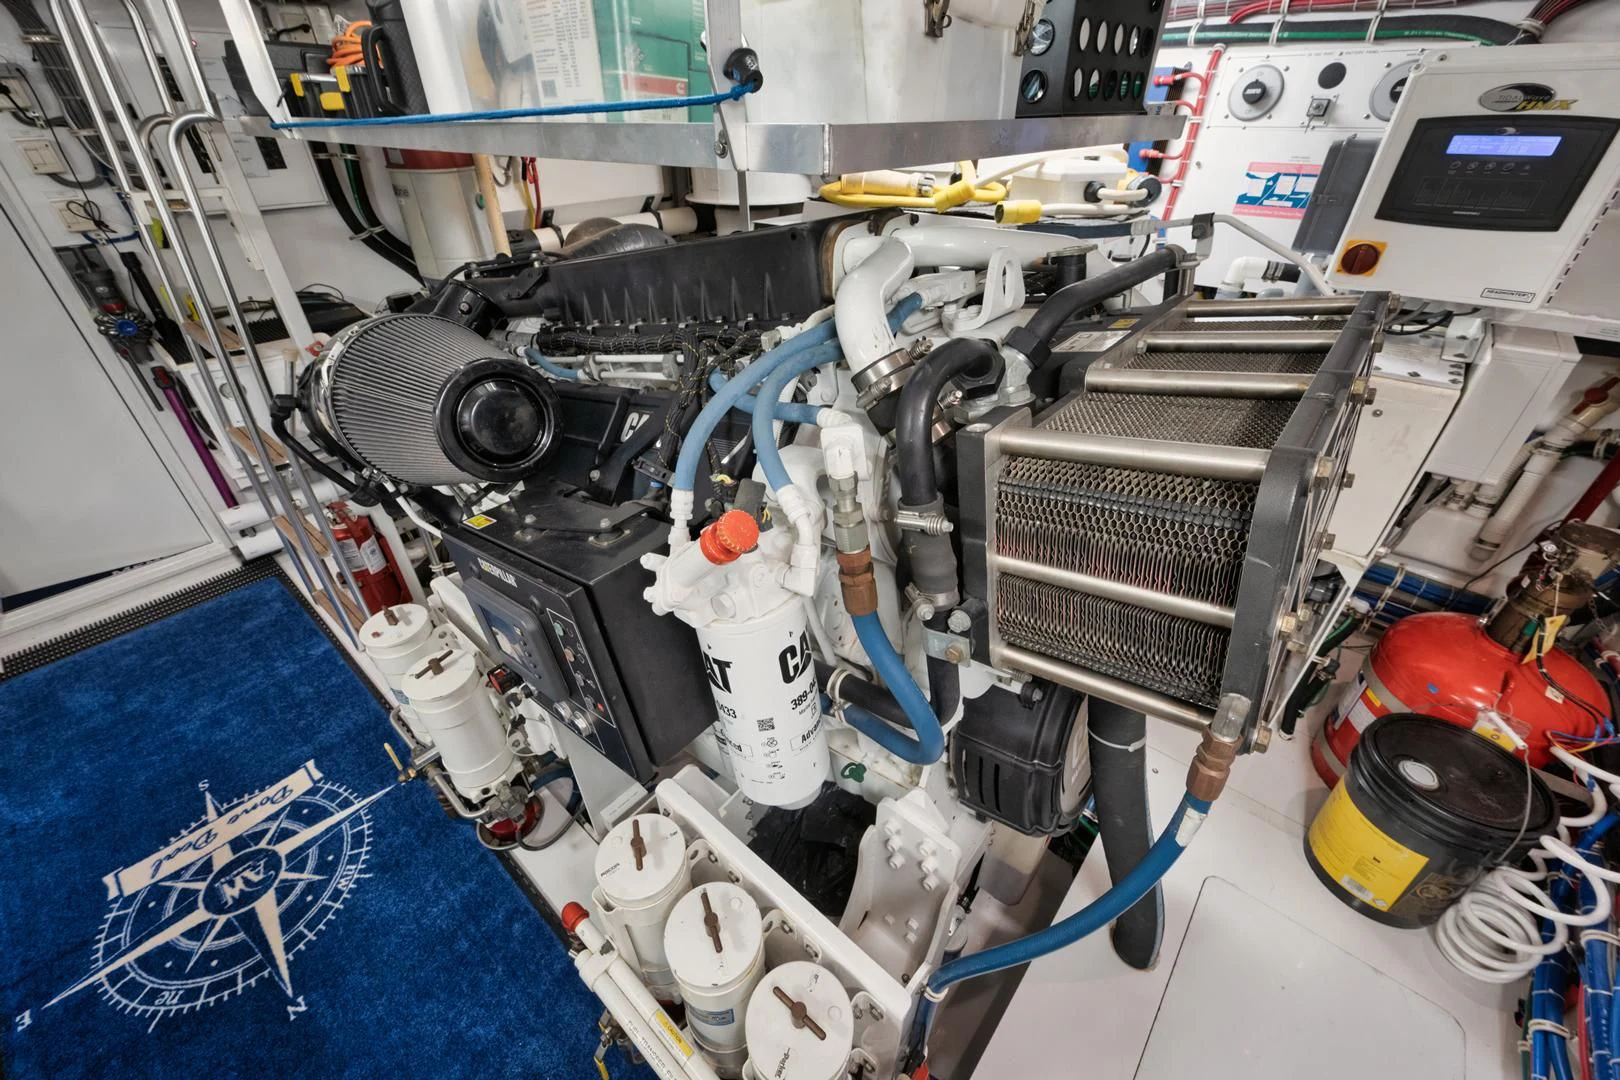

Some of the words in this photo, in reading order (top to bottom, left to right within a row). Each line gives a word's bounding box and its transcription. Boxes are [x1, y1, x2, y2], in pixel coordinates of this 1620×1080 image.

[477, 557, 518, 588] CATERPILLAR
[702, 650, 733, 694] AT
[778, 629, 812, 685] CA
[226, 784, 294, 825] Done
[150, 828, 218, 880] Deal
[15, 1008, 33, 1033] E
[286, 995, 309, 1022] N
